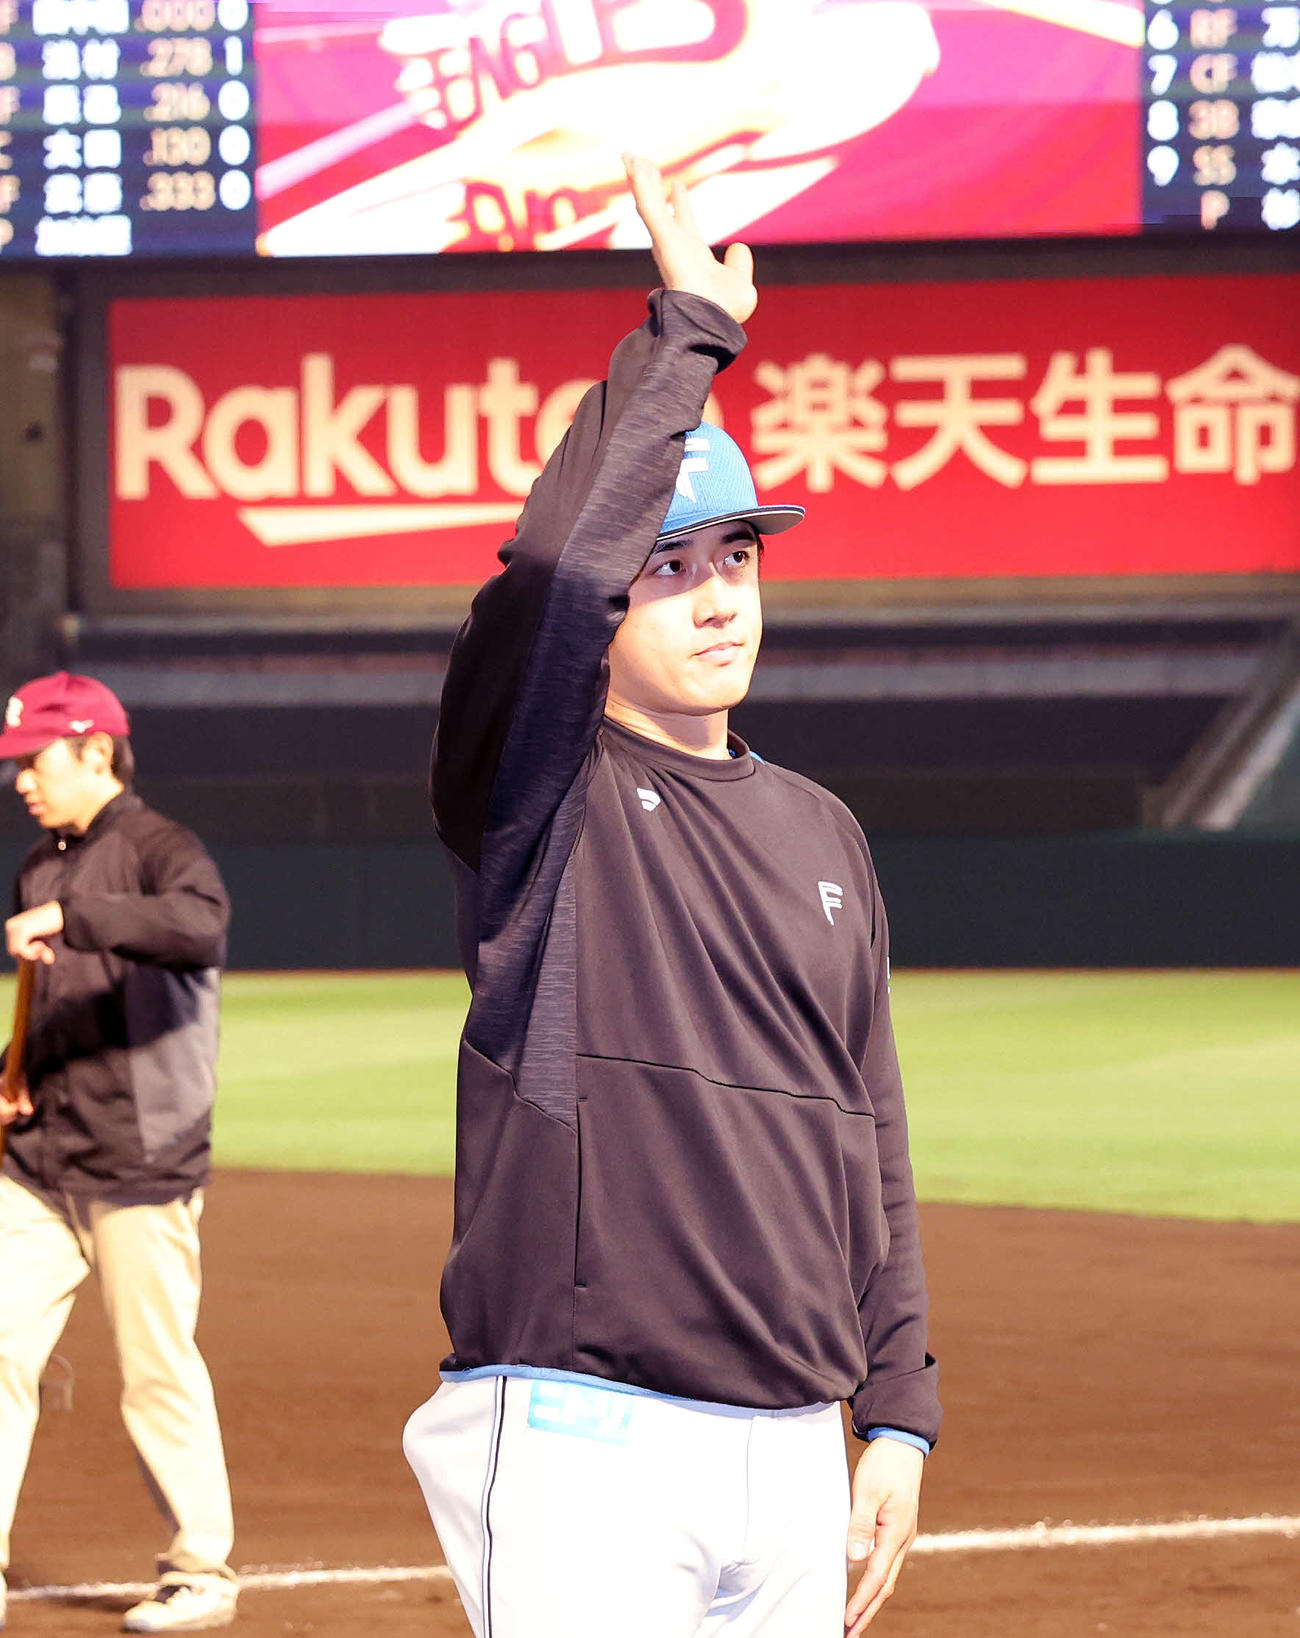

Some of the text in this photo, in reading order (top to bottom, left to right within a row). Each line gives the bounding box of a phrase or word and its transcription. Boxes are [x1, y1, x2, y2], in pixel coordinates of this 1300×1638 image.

[223, 35, 243, 76] 1
[1148, 54, 1178, 96] 7
[114, 353, 724, 500] Rakut
[750, 344, 1300, 494] 楽天生命
[818, 880, 843, 926] F
